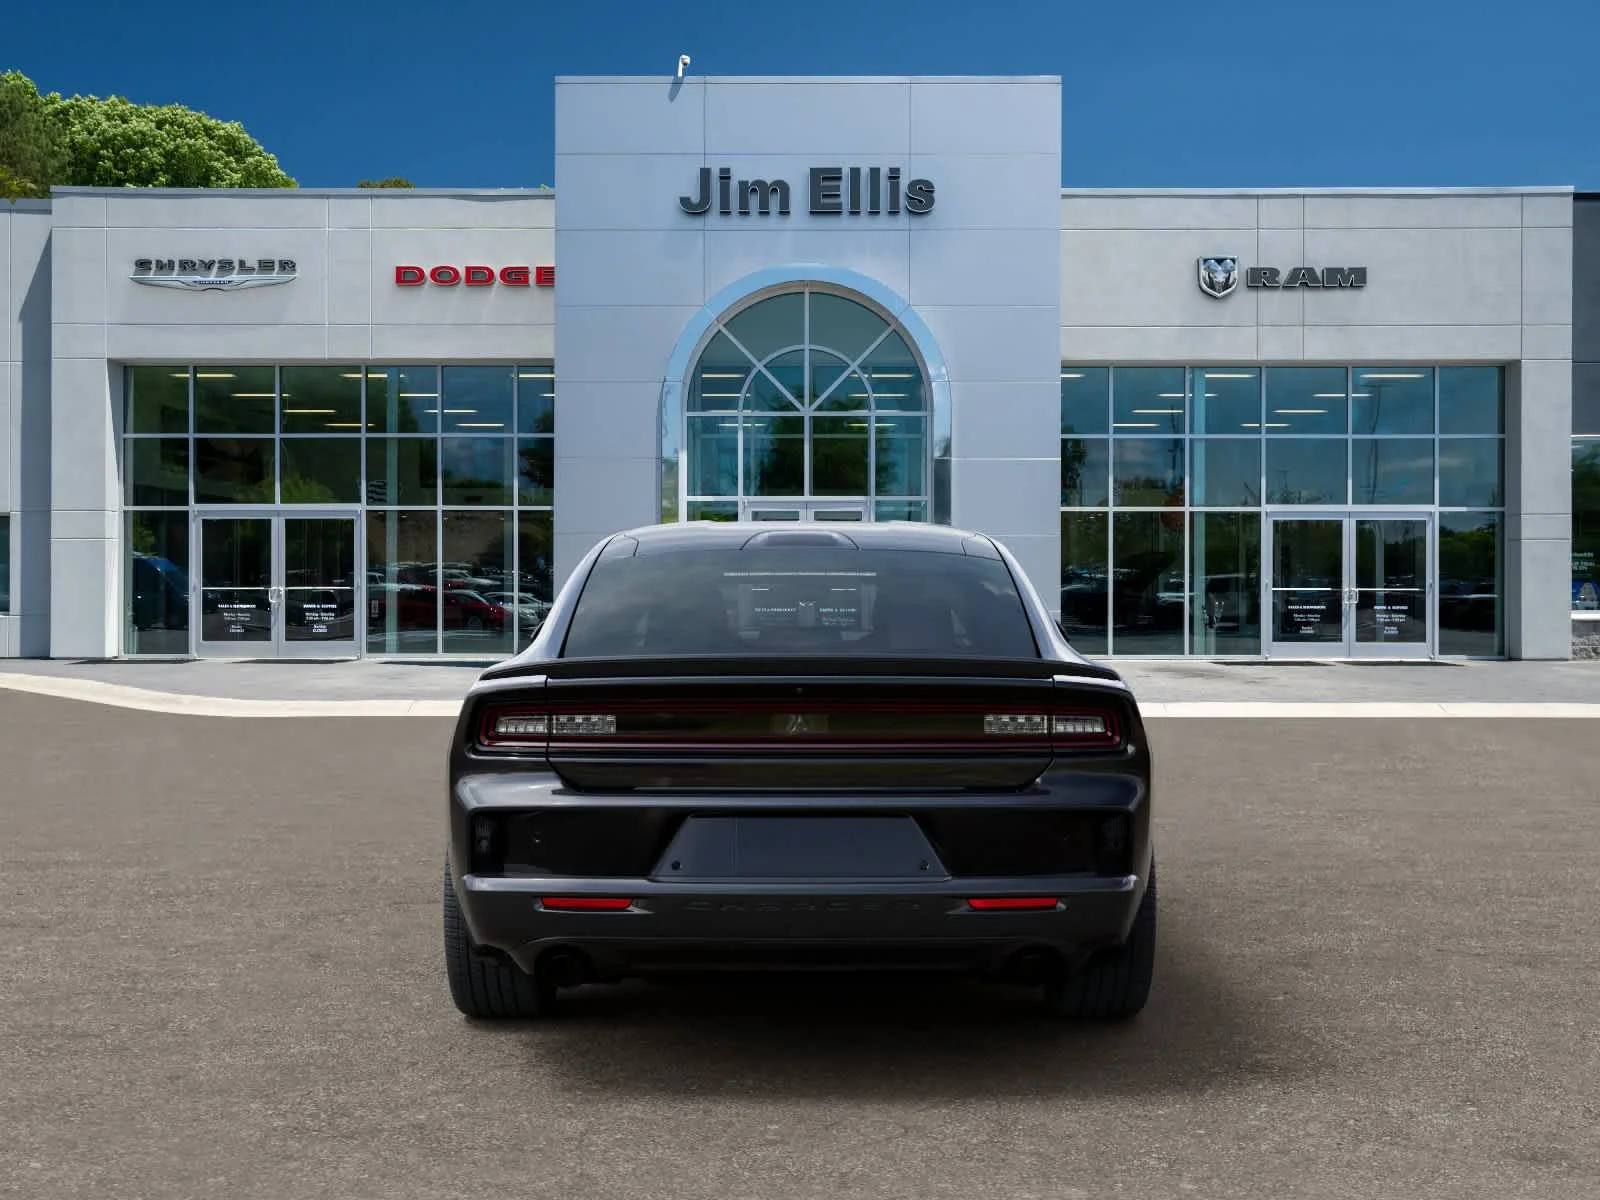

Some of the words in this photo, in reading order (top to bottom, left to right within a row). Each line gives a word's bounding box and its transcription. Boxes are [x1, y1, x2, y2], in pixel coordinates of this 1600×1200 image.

[679, 167, 791, 214] Jim
[808, 167, 936, 214] Ellis
[134, 258, 296, 272] CHRYSLER
[395, 265, 555, 286] DODGE
[1246, 266, 1367, 288] RAM
